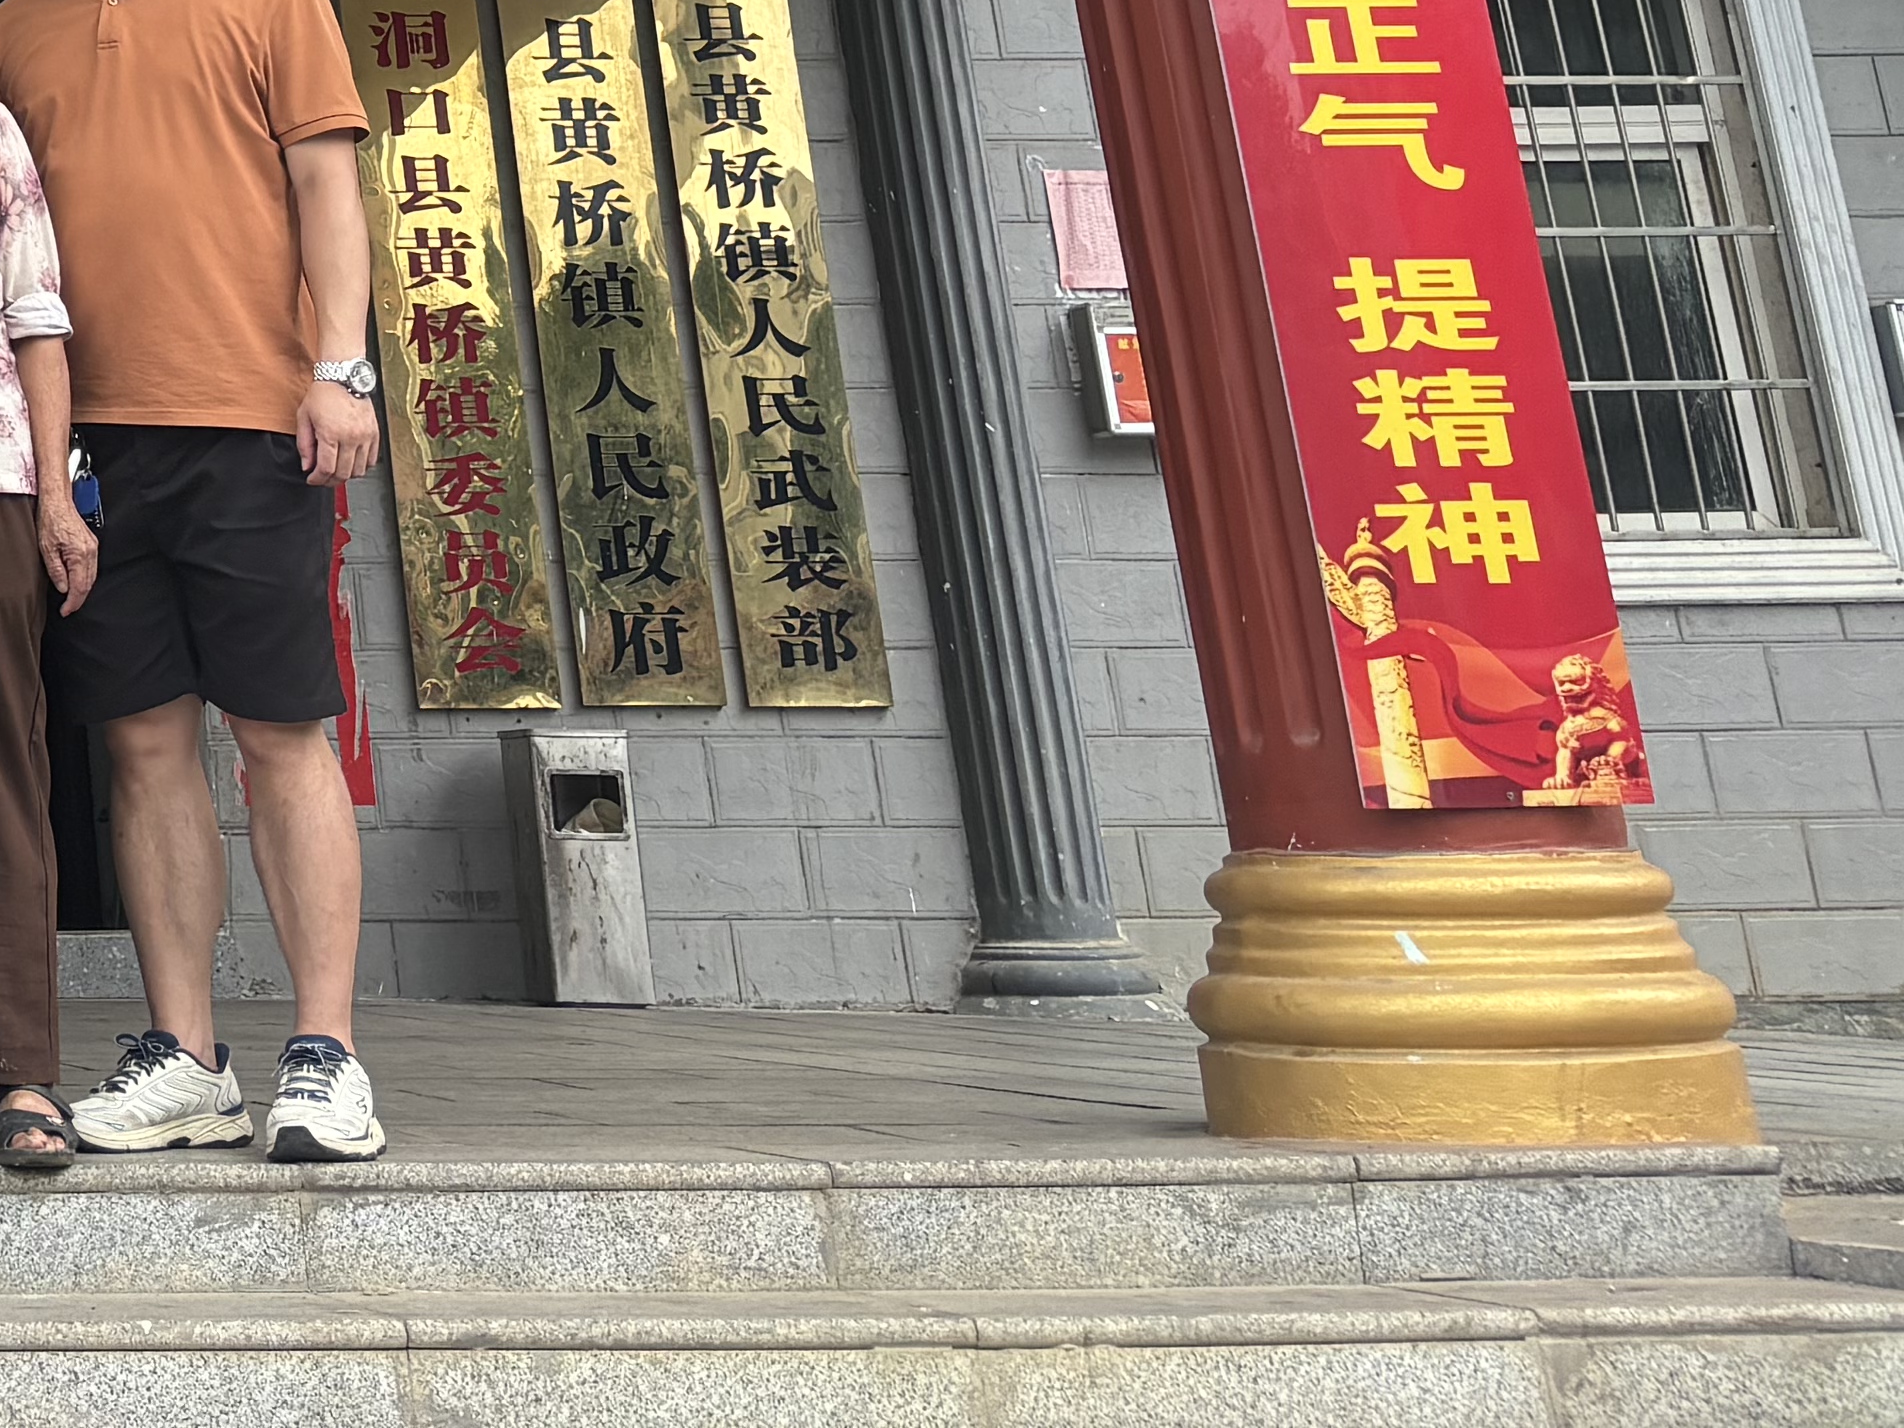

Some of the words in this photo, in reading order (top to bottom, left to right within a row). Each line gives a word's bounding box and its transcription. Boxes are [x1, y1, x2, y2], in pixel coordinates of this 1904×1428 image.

[367, 10, 527, 675] 洞口县黄桥镇委员会
[1331, 256, 1539, 584] 提精神
